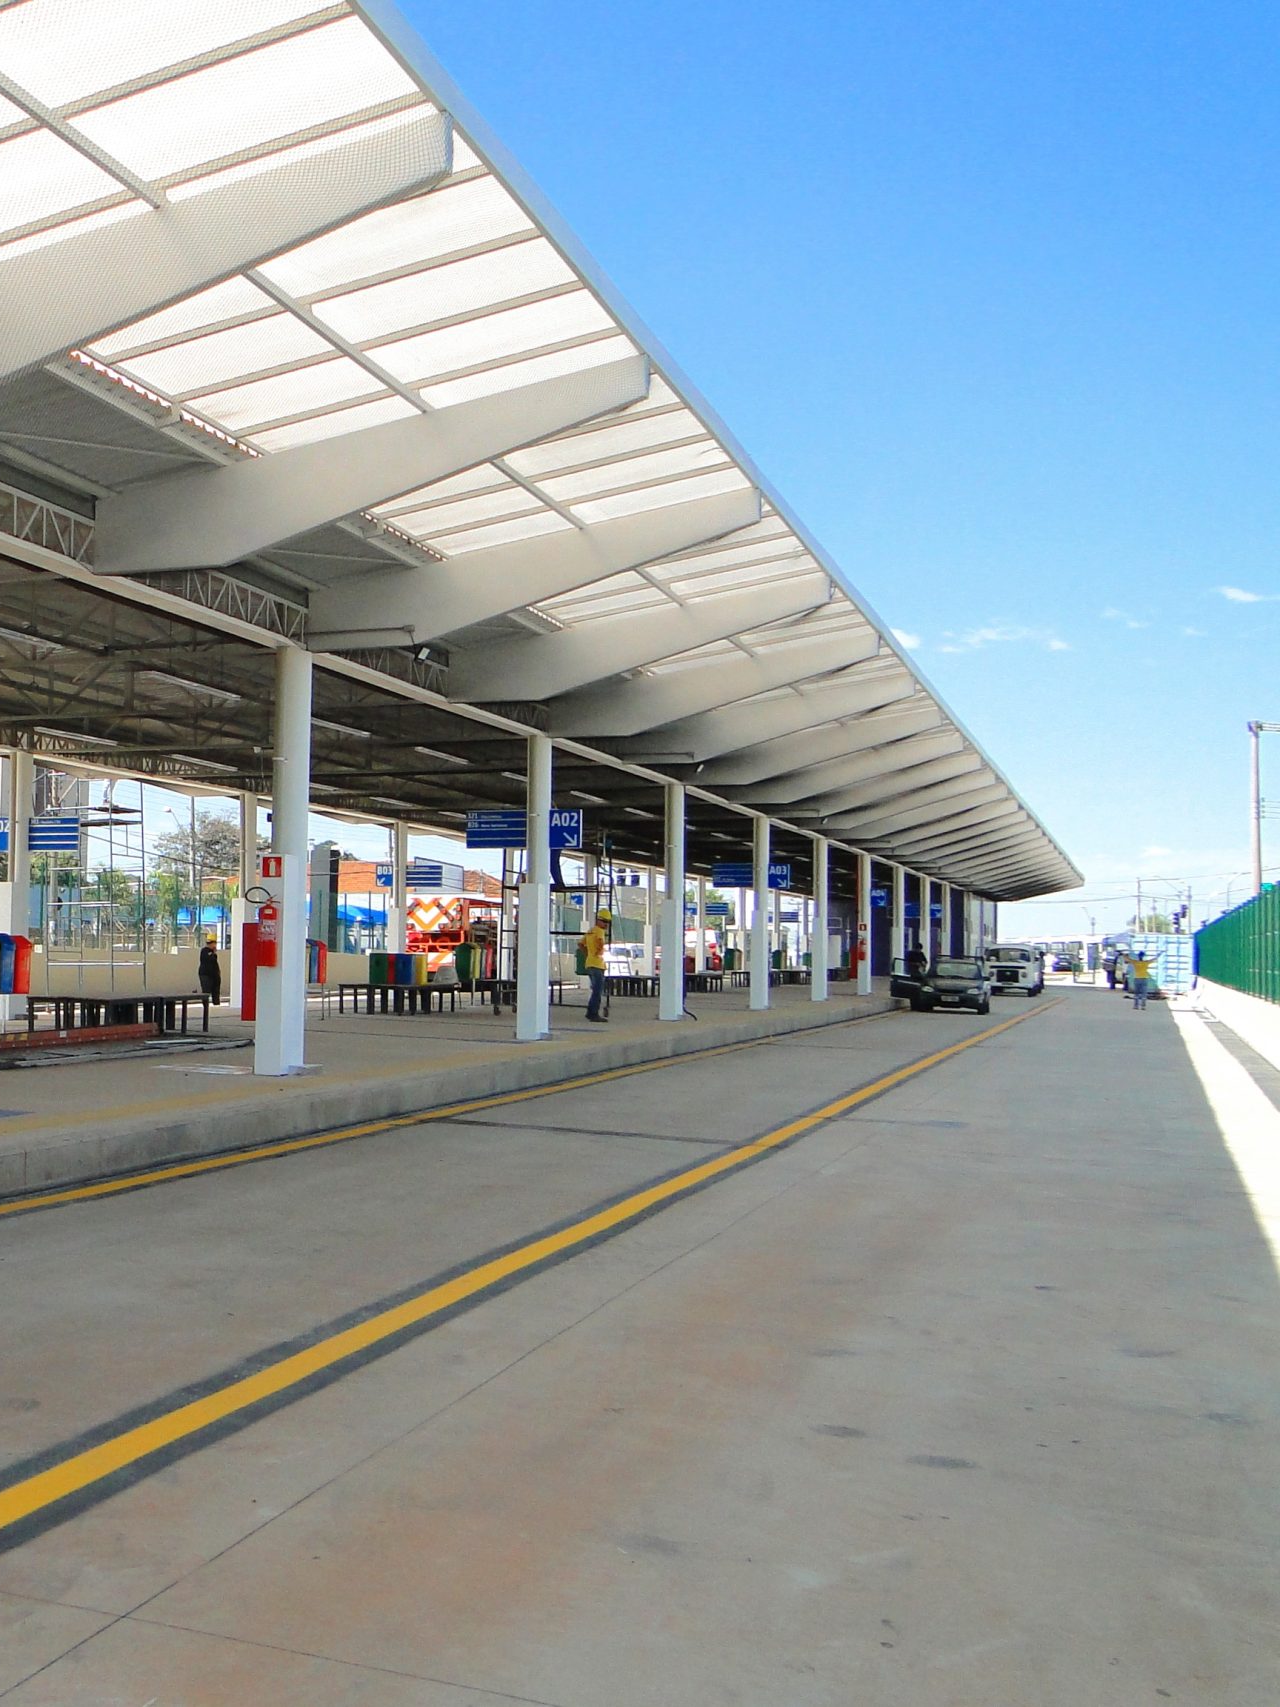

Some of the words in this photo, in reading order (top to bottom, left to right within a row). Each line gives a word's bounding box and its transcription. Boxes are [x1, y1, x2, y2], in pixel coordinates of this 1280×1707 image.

[551, 812, 578, 827] A02
[377, 866, 392, 875] B03
[769, 865, 787, 875] A03
